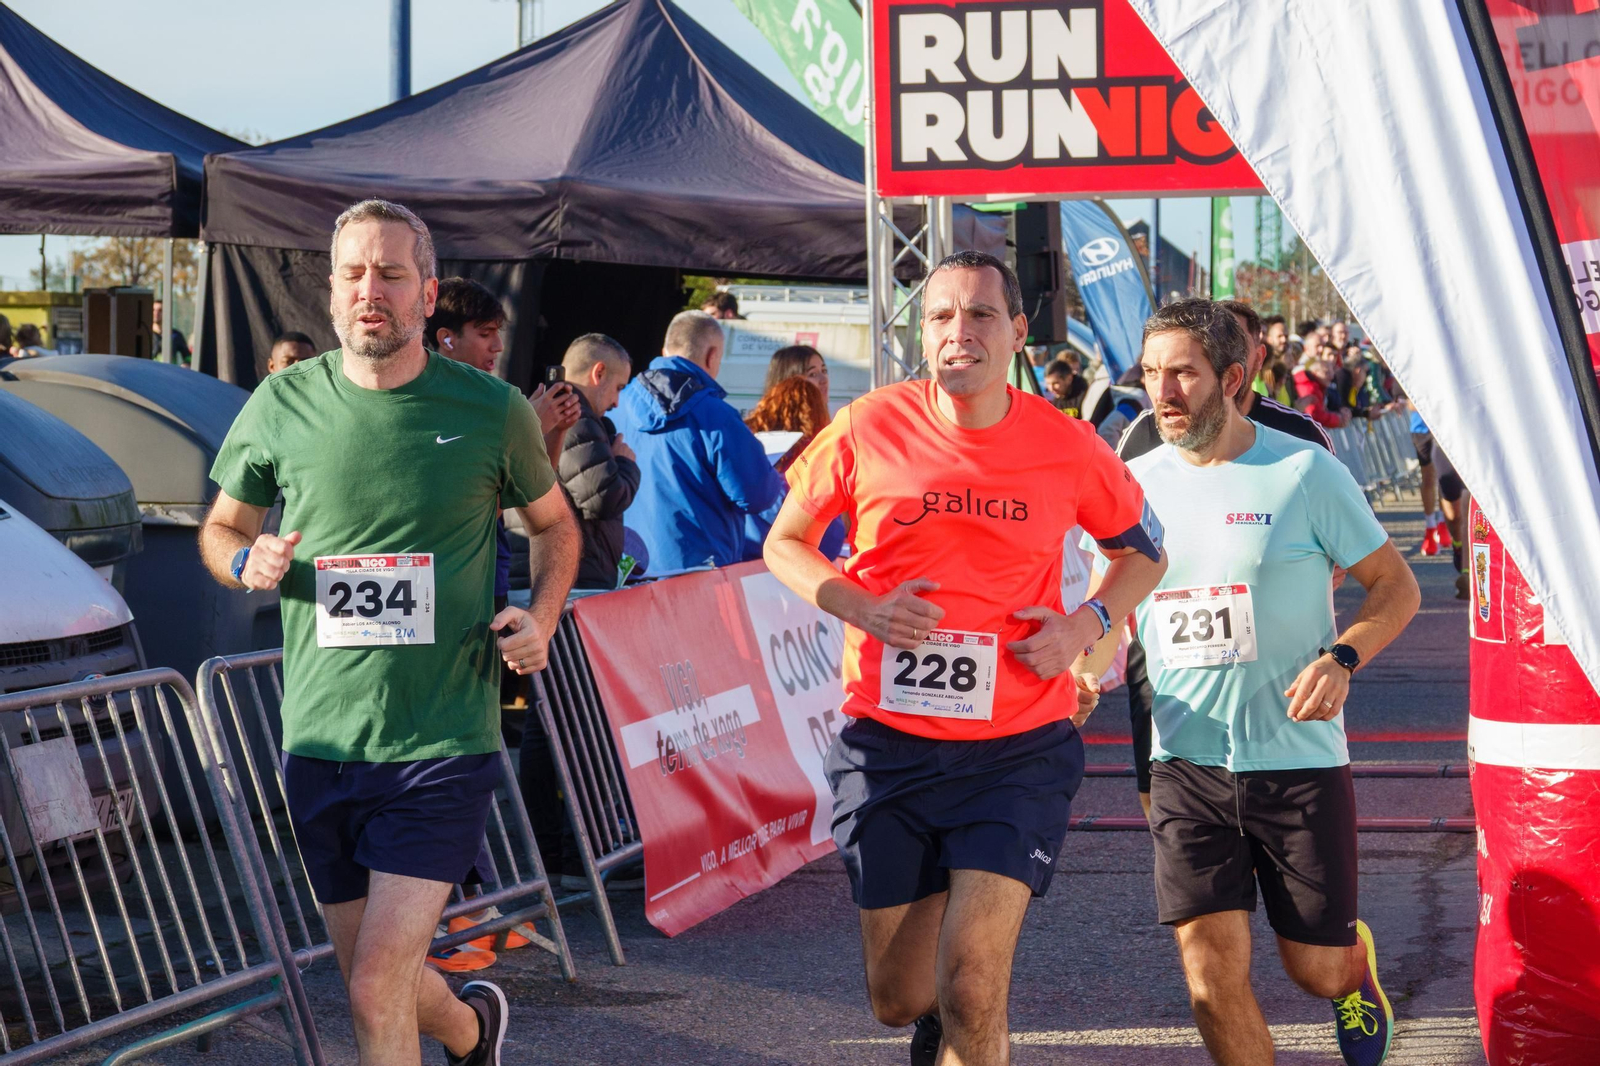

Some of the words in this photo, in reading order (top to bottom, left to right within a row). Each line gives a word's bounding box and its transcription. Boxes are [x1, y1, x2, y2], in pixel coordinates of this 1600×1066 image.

[899, 8, 1098, 85] RUN
[893, 488, 1028, 526] galicia
[1225, 512, 1273, 526] SERVI
[328, 580, 417, 619] 234
[1169, 607, 1233, 644] 231
[893, 650, 978, 693] 228
[693, 713, 717, 760] de
[710, 709, 748, 759] xogo
[720, 846, 726, 866] A
[728, 832, 758, 862] MELLOR
[769, 817, 787, 839] PARA
[787, 809, 808, 831] VIVIR
